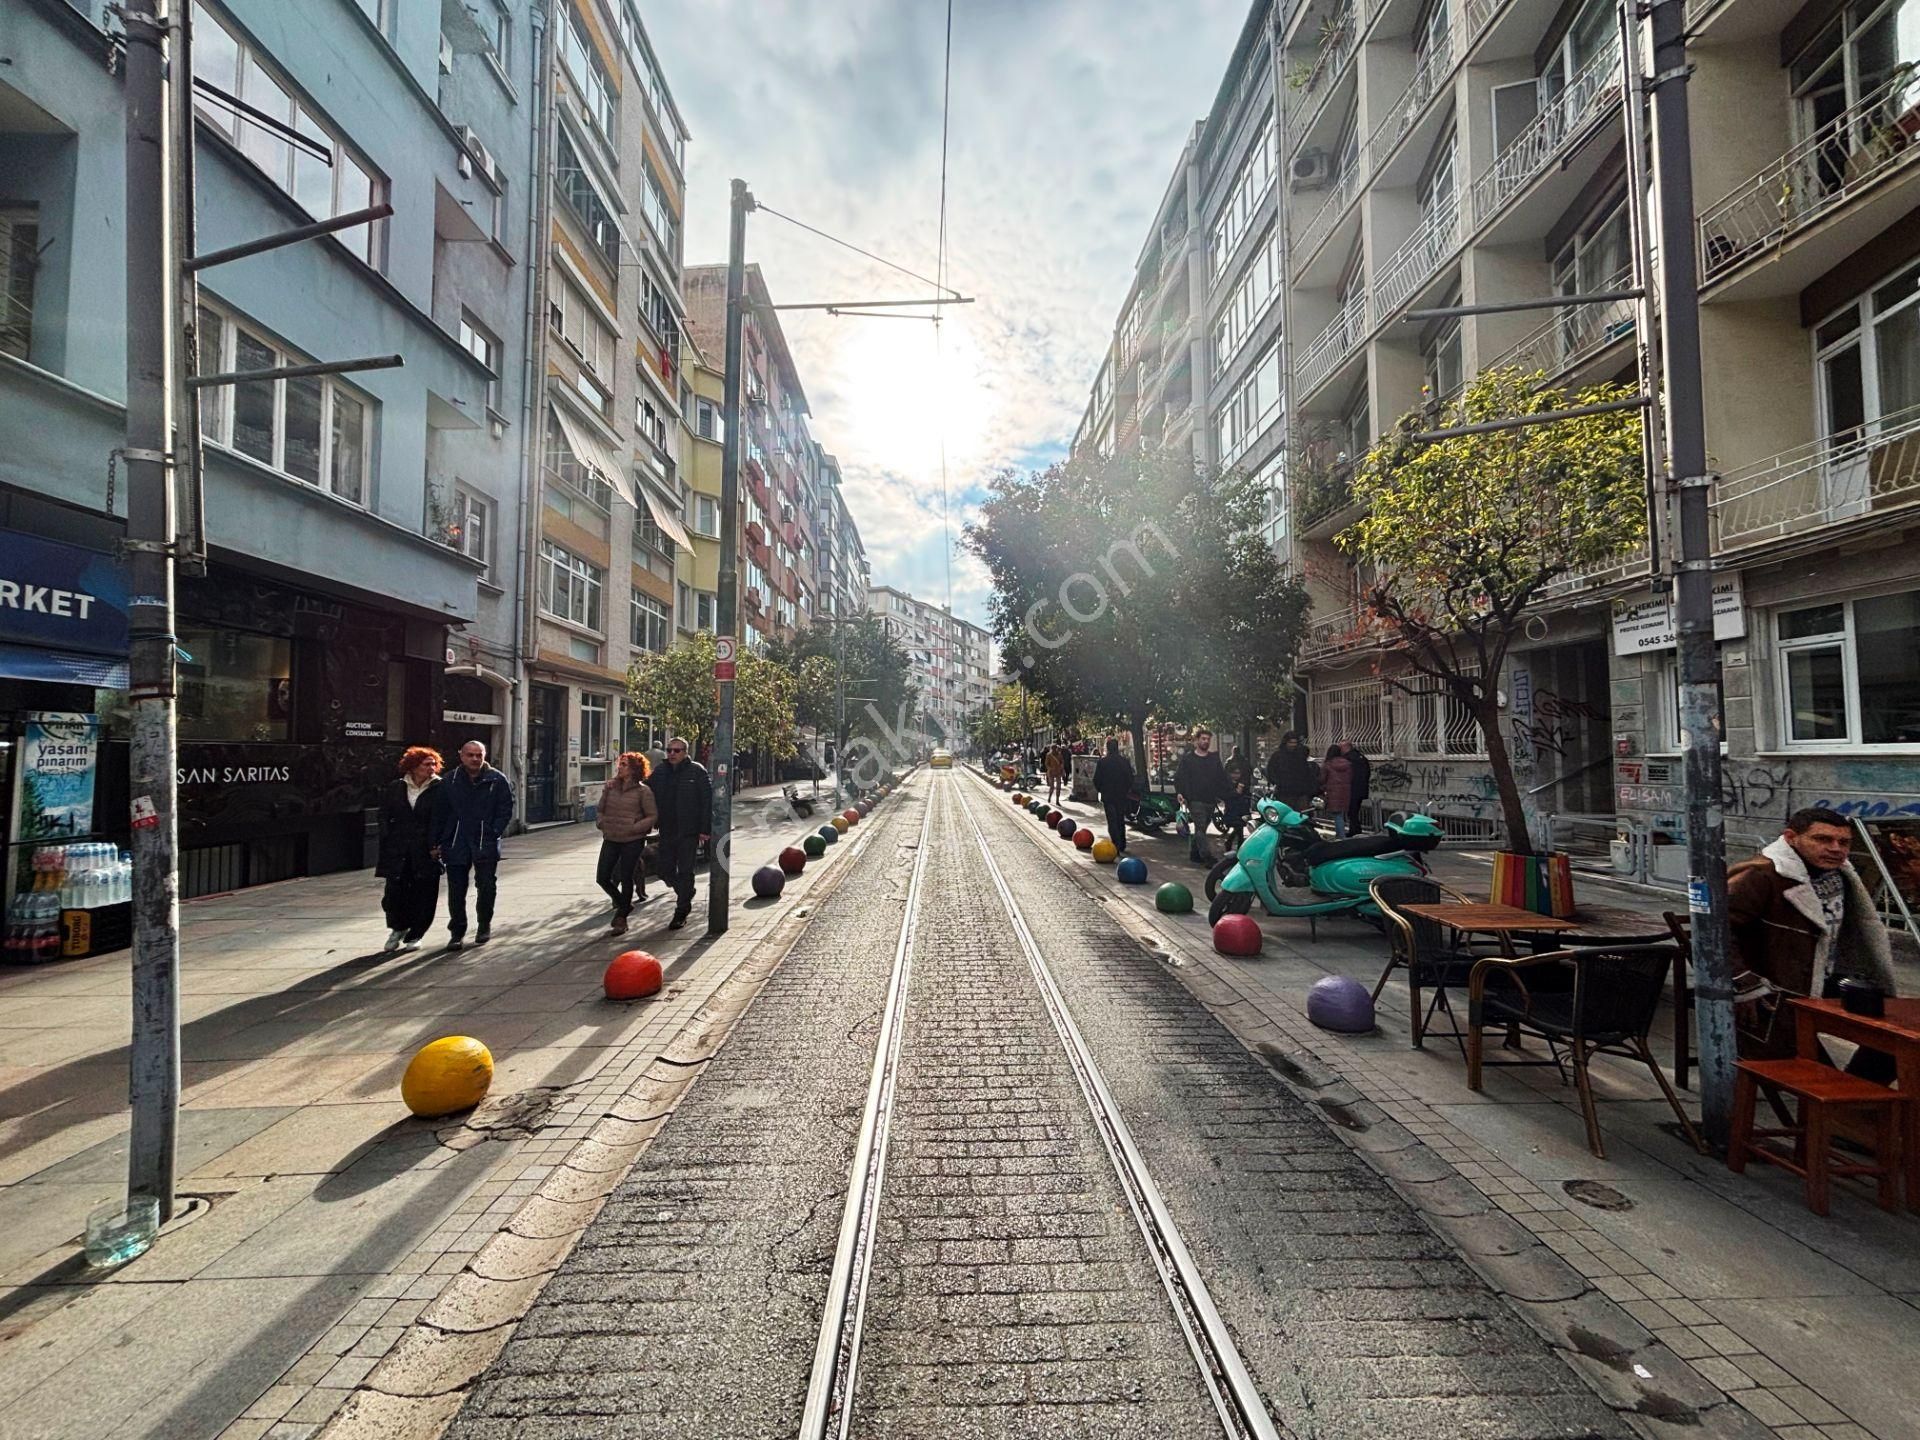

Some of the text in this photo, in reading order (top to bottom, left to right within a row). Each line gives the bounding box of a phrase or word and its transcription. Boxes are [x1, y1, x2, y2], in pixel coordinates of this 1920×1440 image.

[0, 578, 95, 619] RKET
[1638, 635, 1661, 647] 0545
[345, 722, 372, 730] AUCTION
[345, 730, 385, 738] CONSULTANCY
[38, 743, 88, 758] yaşam
[36, 757, 87, 769] pınarım
